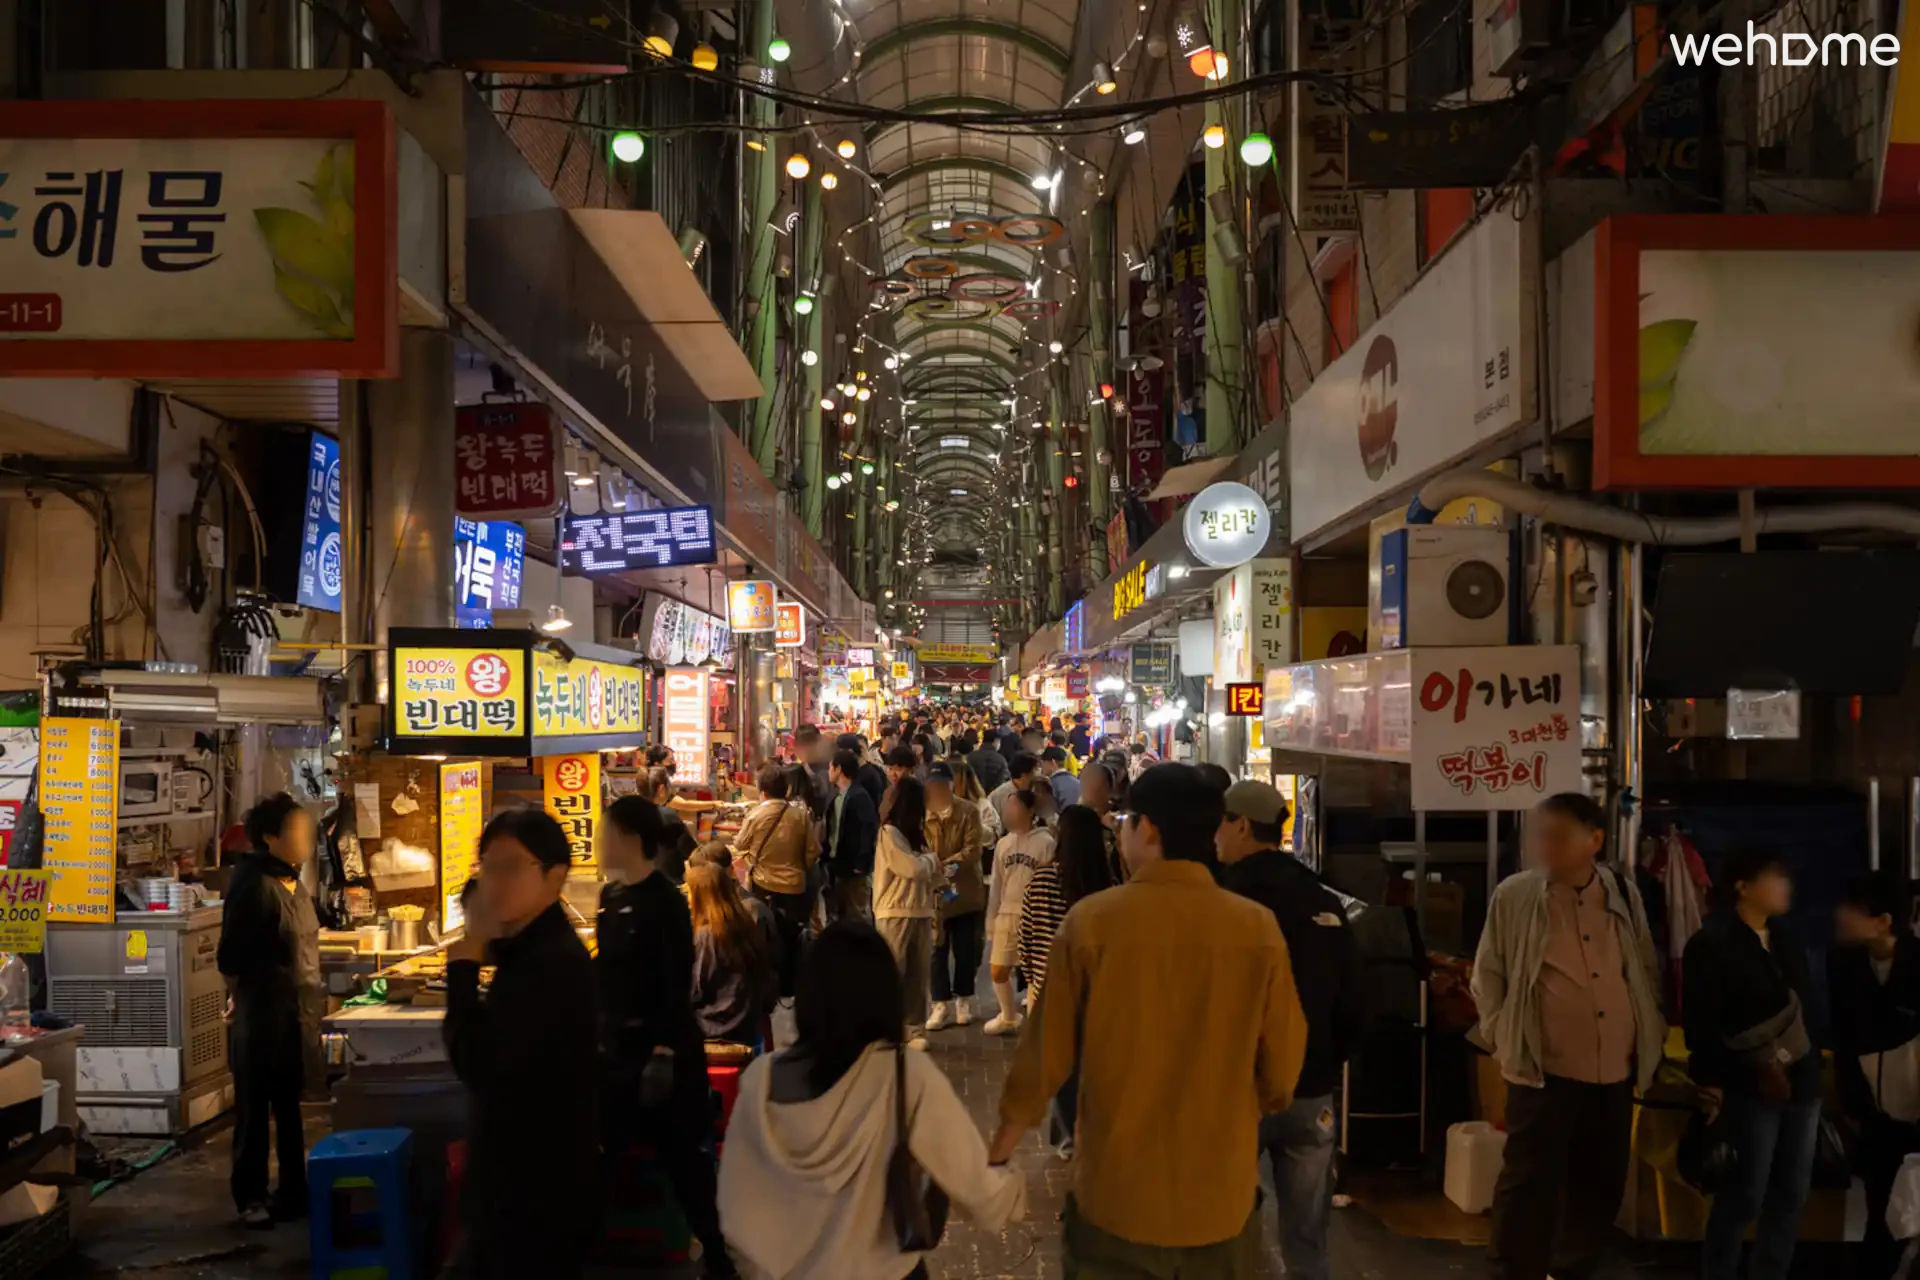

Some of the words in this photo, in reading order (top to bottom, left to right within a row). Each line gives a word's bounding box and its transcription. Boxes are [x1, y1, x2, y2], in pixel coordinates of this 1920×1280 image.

[0, 169, 227, 273] 해물
[461, 469, 549, 504] 빈대떡
[1200, 508, 1258, 540] 젤리칸
[1260, 581, 1283, 661] 젤리칸
[406, 658, 456, 674] 100%
[469, 656, 508, 694] 왕
[407, 678, 456, 693] 녹두네
[604, 675, 641, 726] 빈대떡
[1231, 686, 1263, 713] 칸
[1419, 668, 1562, 724] 이가네
[404, 698, 517, 733] 빈대떡
[558, 759, 586, 790] 왕
[1440, 743, 1547, 794] 떡볶이
